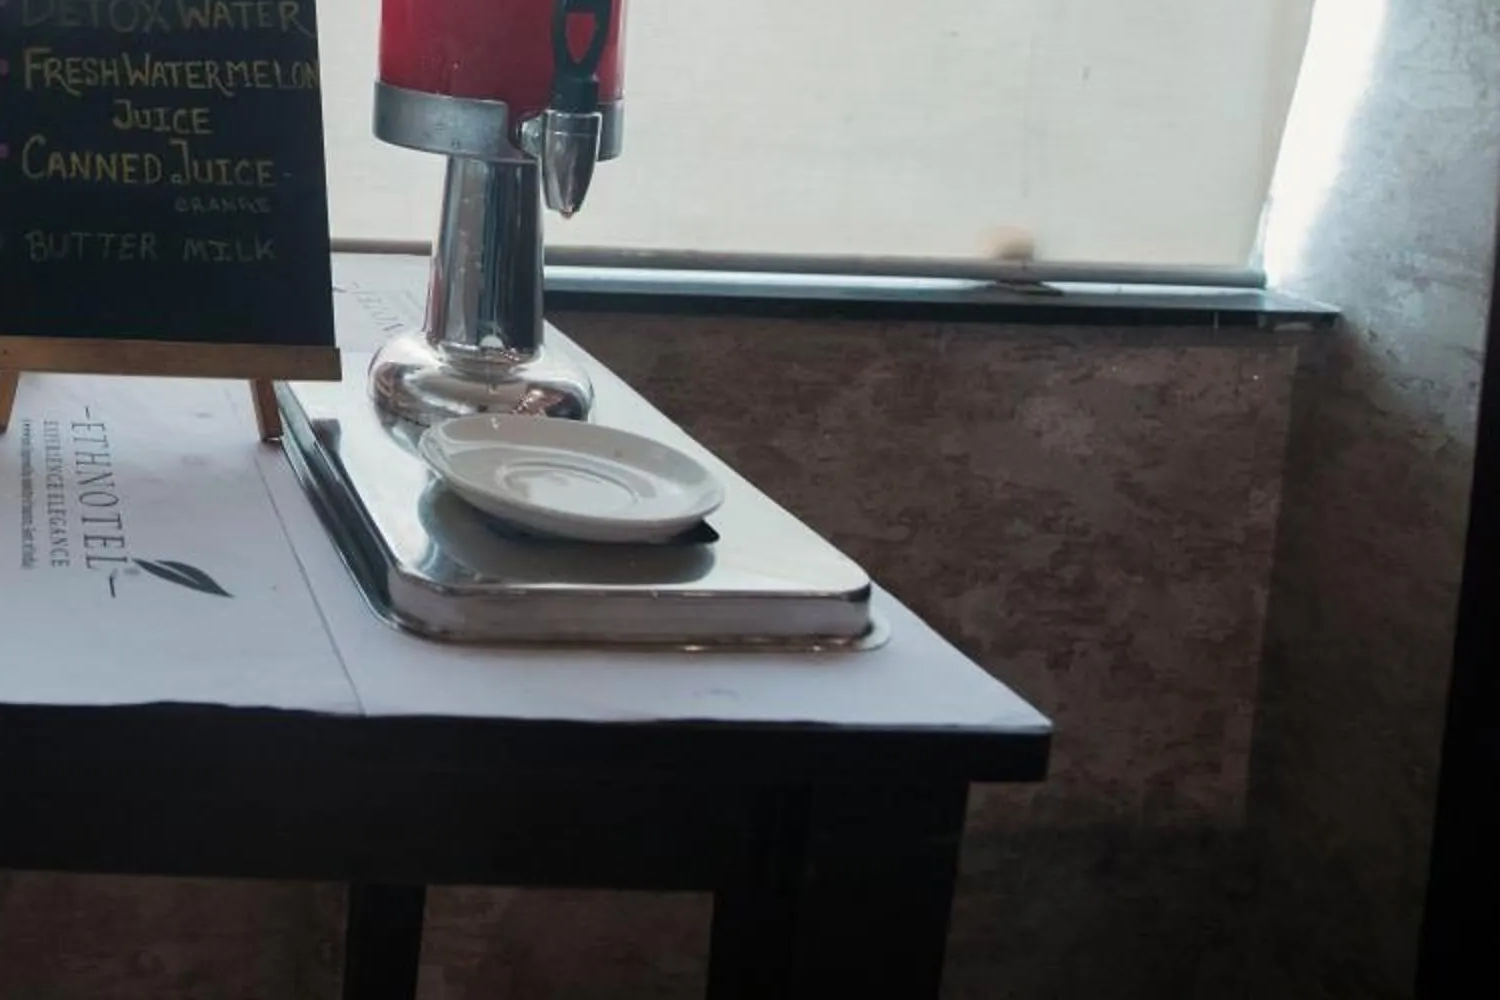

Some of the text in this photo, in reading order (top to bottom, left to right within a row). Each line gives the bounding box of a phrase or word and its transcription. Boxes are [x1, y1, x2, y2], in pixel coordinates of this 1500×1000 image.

[23, 46, 120, 96] FRESH
[112, 98, 213, 136] JUICE
[21, 134, 164, 185] CANNED
[24, 229, 277, 263] BUTTER MILK
